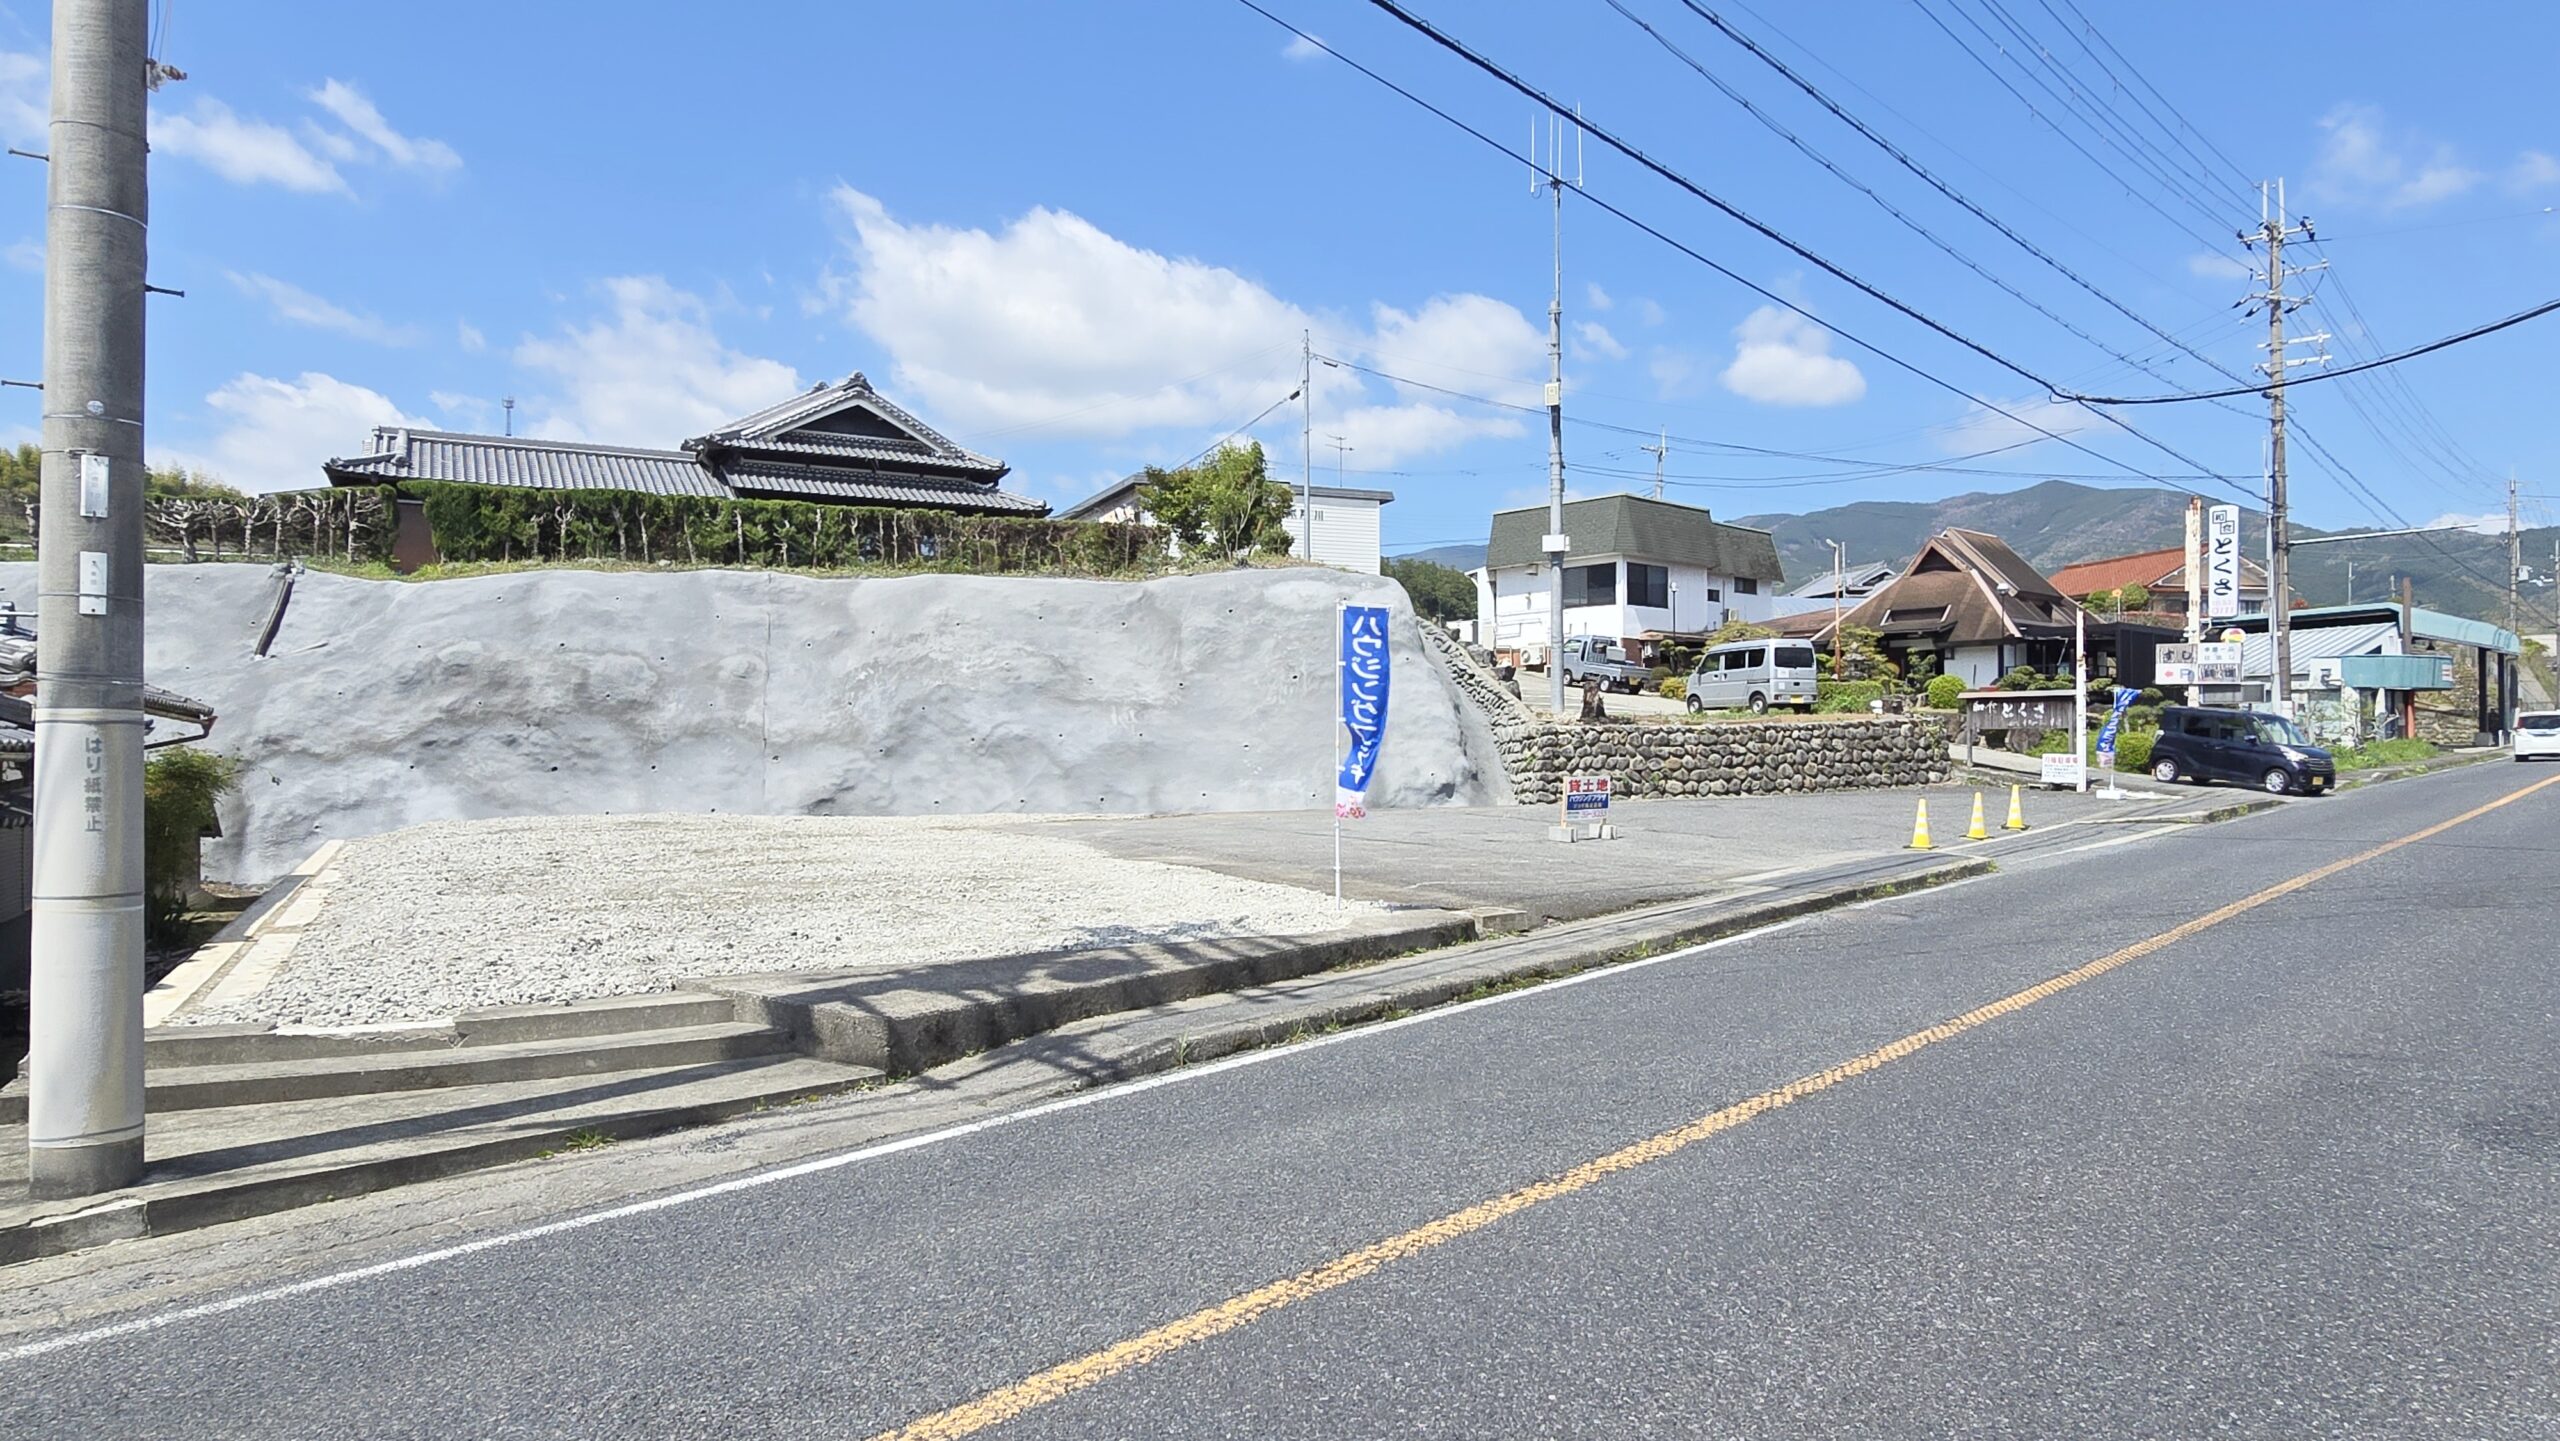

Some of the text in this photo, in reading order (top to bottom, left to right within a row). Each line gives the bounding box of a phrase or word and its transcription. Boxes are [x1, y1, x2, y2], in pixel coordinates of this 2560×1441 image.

[2001, 702, 2045, 719] とくさ
[83, 736, 103, 833] はり紙禁止
[1568, 779, 1609, 792] 貸土地
